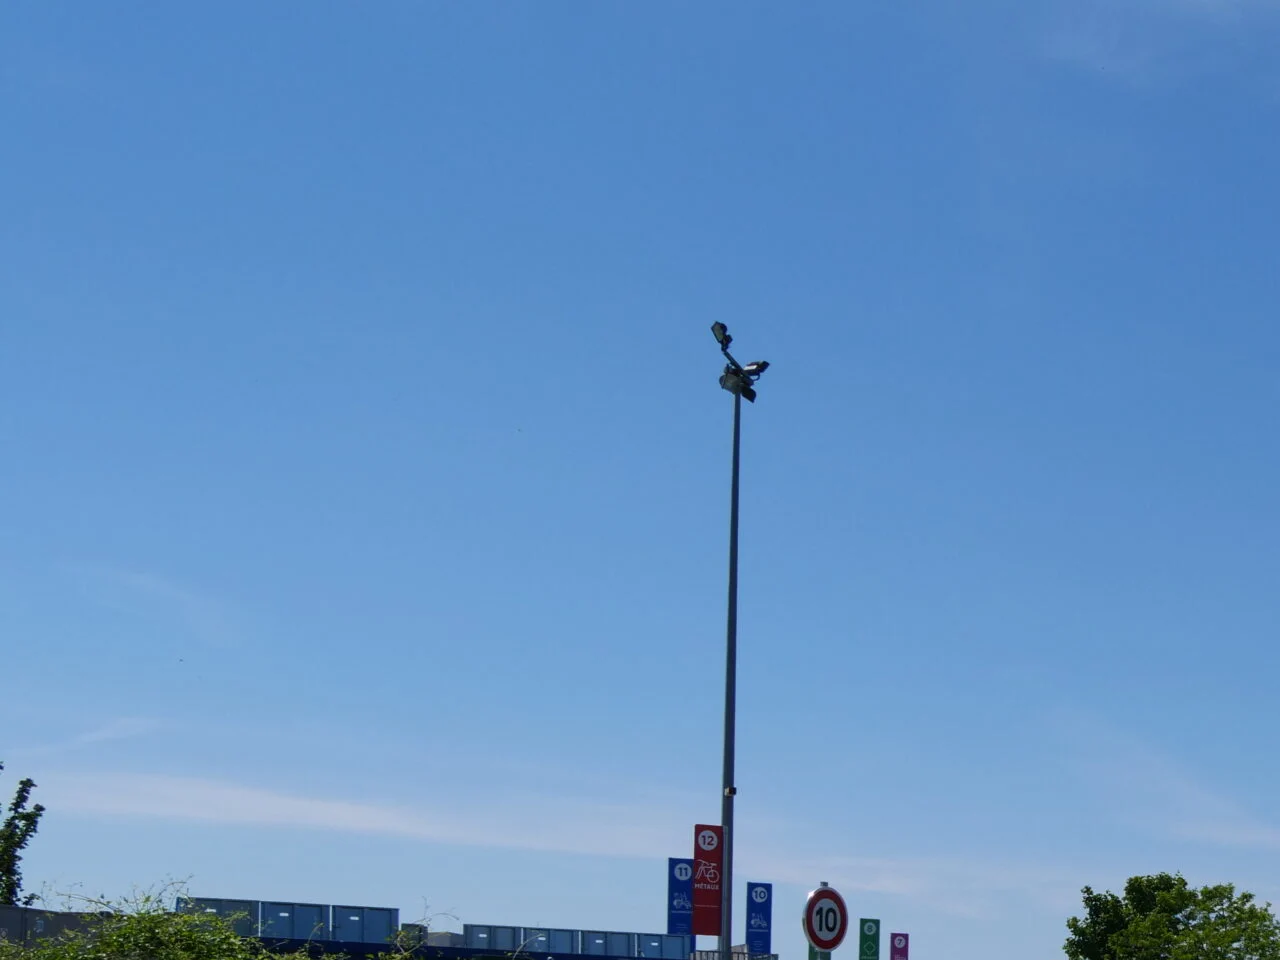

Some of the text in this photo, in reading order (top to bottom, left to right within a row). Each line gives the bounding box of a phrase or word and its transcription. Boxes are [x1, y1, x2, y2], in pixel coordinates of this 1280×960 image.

[702, 835, 715, 846] 12
[677, 866, 688, 877] 11
[694, 881, 720, 890] MÉTAUX
[754, 890, 767, 899] 10
[815, 906, 838, 933] 10
